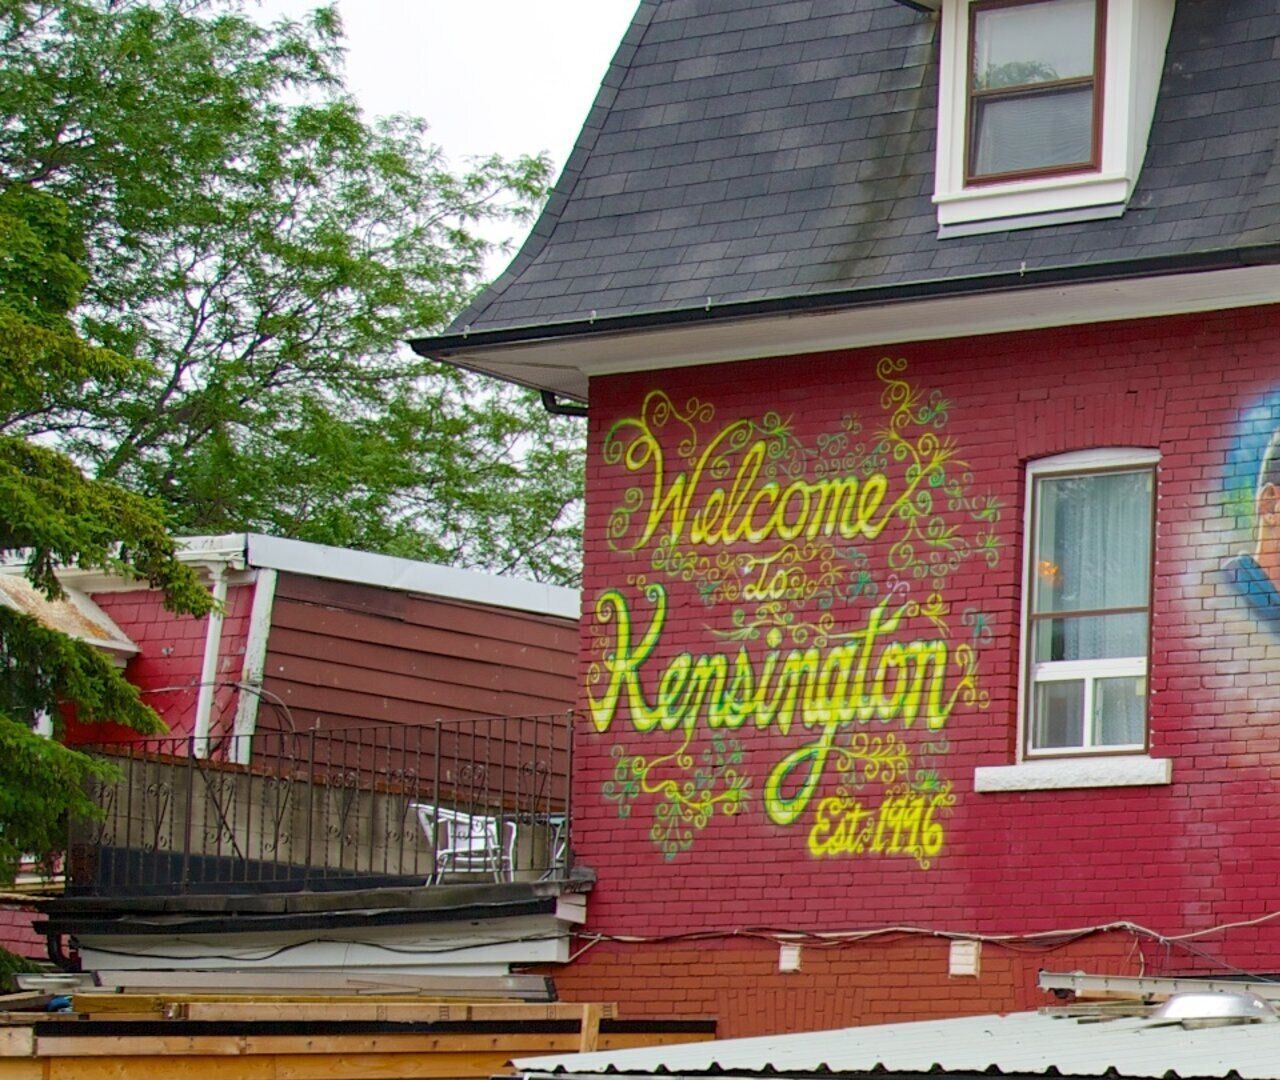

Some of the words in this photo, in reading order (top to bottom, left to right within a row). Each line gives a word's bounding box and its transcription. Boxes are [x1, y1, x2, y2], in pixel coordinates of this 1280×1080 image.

[614, 418, 890, 552] Welcome
[743, 557, 788, 601] To
[588, 582, 955, 826] Kensington
